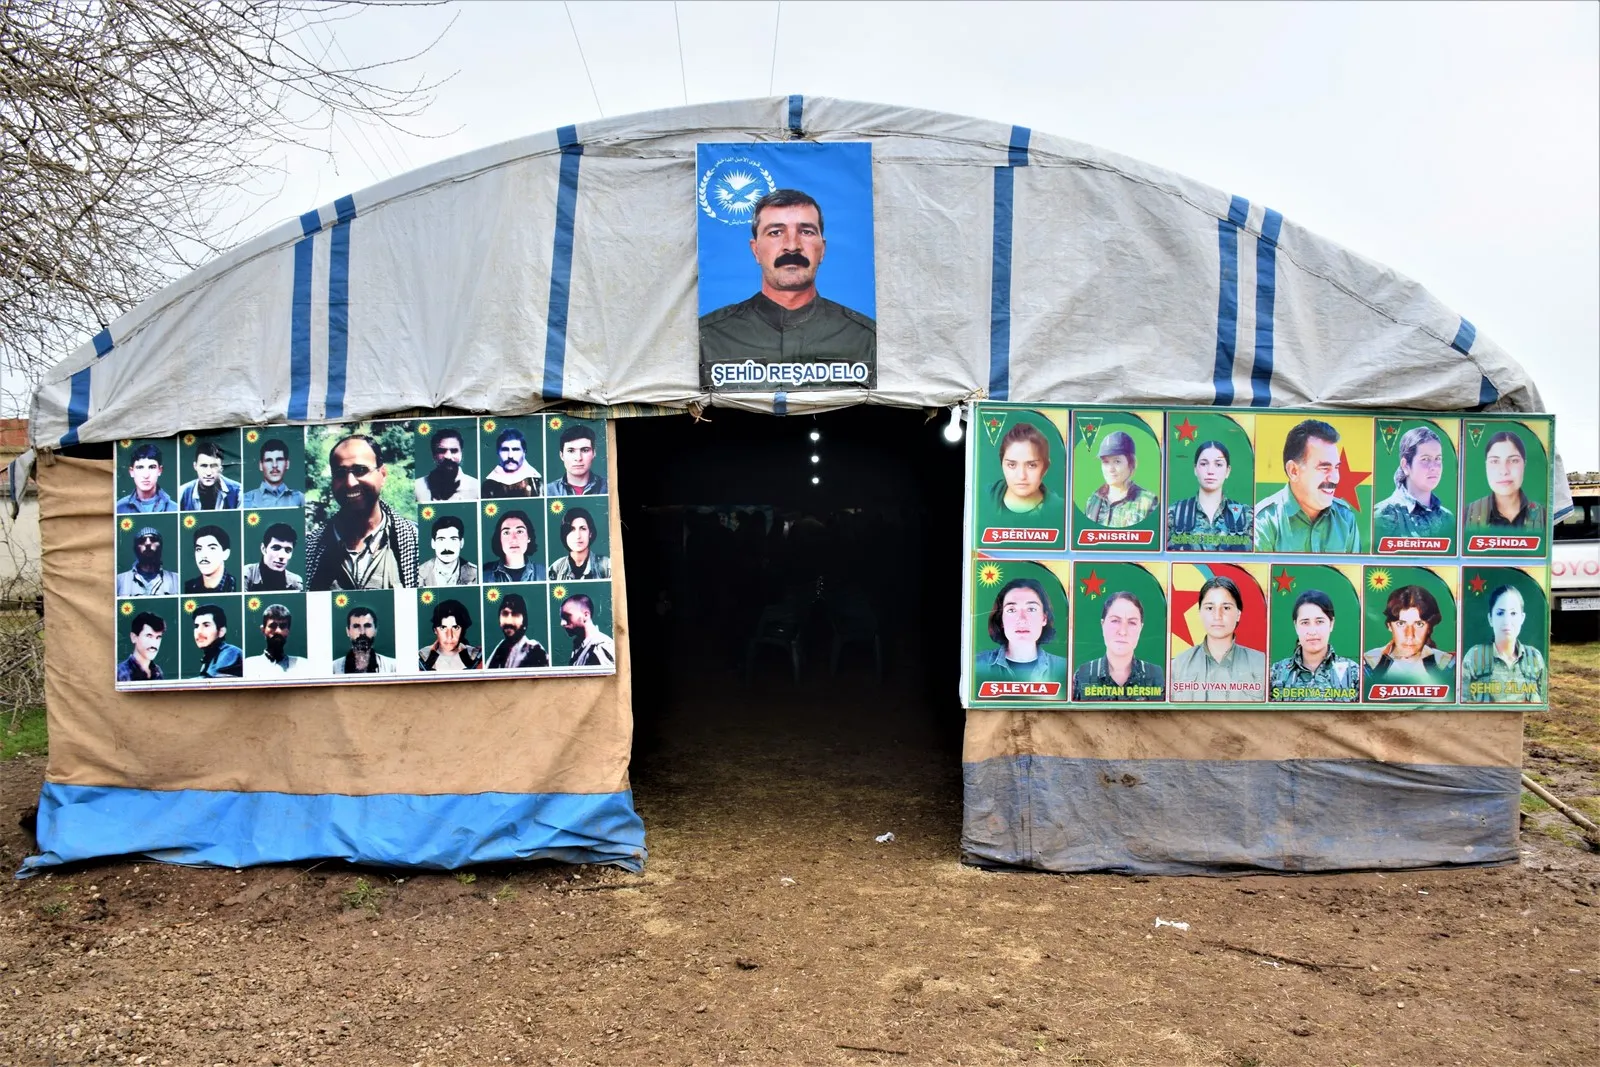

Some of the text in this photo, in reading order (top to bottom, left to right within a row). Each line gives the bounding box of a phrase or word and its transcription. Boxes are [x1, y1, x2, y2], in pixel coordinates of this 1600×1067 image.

[713, 361, 866, 385] ŞEHÎD REŞAD ELO
[990, 683, 1048, 695] Ş.LEYLA
[1229, 682, 1261, 691] MURAD
[1379, 686, 1440, 698] Ş.ADALET
